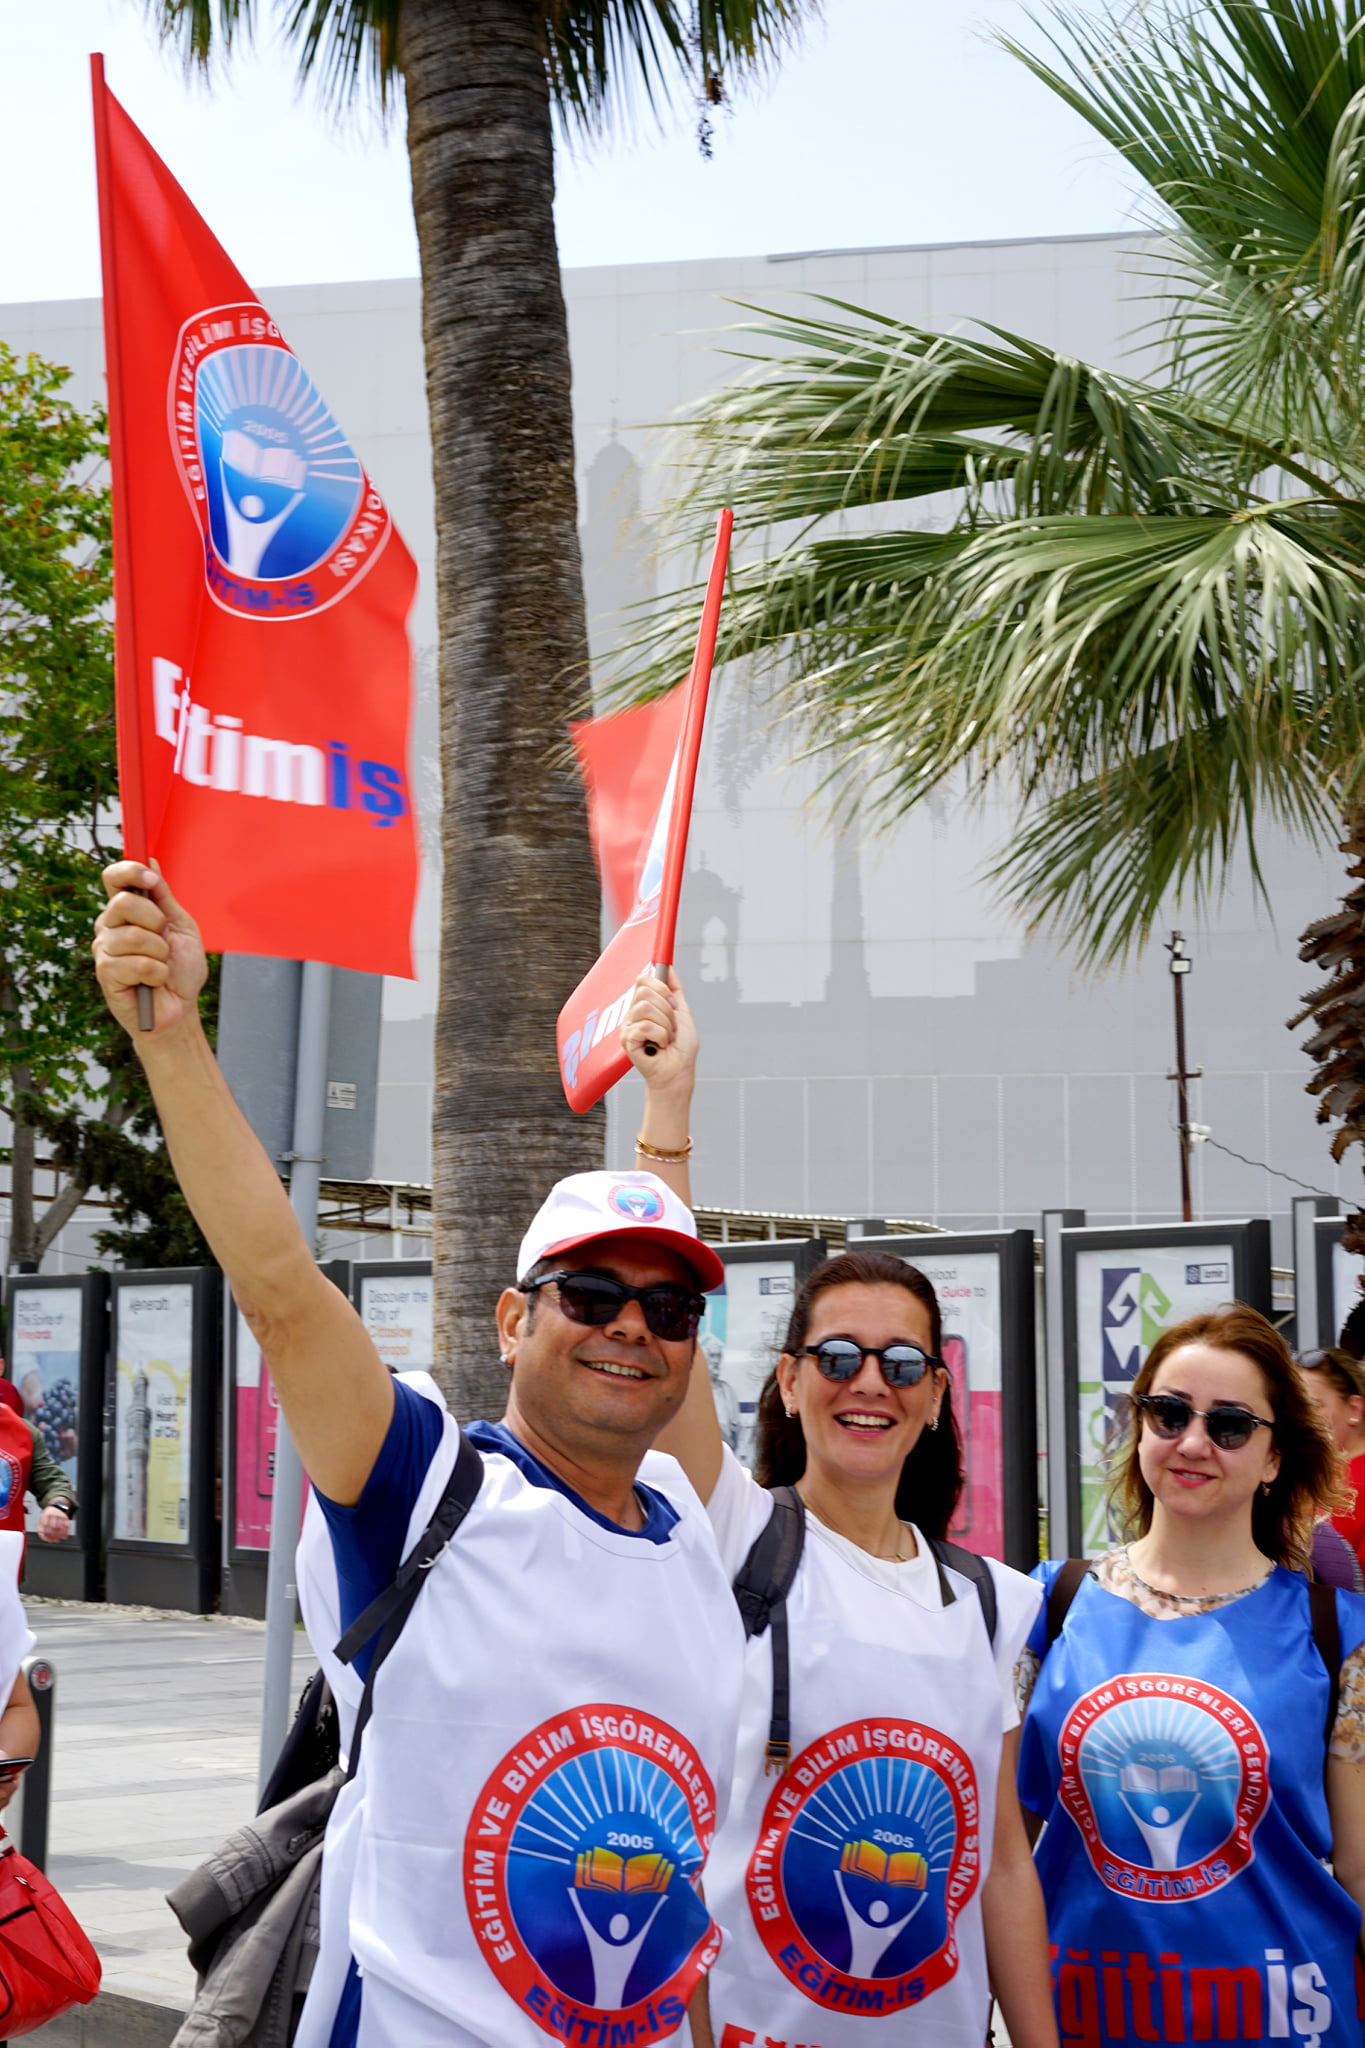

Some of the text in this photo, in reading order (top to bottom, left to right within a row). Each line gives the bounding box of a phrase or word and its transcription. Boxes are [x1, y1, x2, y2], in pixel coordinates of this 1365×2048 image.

[1068, 1691, 1114, 1737] BİLİM
[1116, 1679, 1251, 1737] İŞGÖRENLERİ
[1138, 1752, 1176, 1763] 2005
[469, 1713, 717, 1963] EĞİTİM VE BİLİM İŞGÖRENLERİ
[606, 1831, 655, 1850] 2005
[751, 1829, 782, 1922] EĞİTİM
[774, 1788, 801, 1820] VE
[798, 1734, 858, 1787] BİLİM
[863, 1725, 979, 1827] İŞGÖRENLERİ
[873, 1828, 915, 1849] 2005
[1102, 1859, 1230, 1897] EĞİTİM-İŞ
[778, 1942, 926, 2010] EĞİTİM-İŞ
[523, 1984, 687, 2047] EĞİTİM-İŞ
